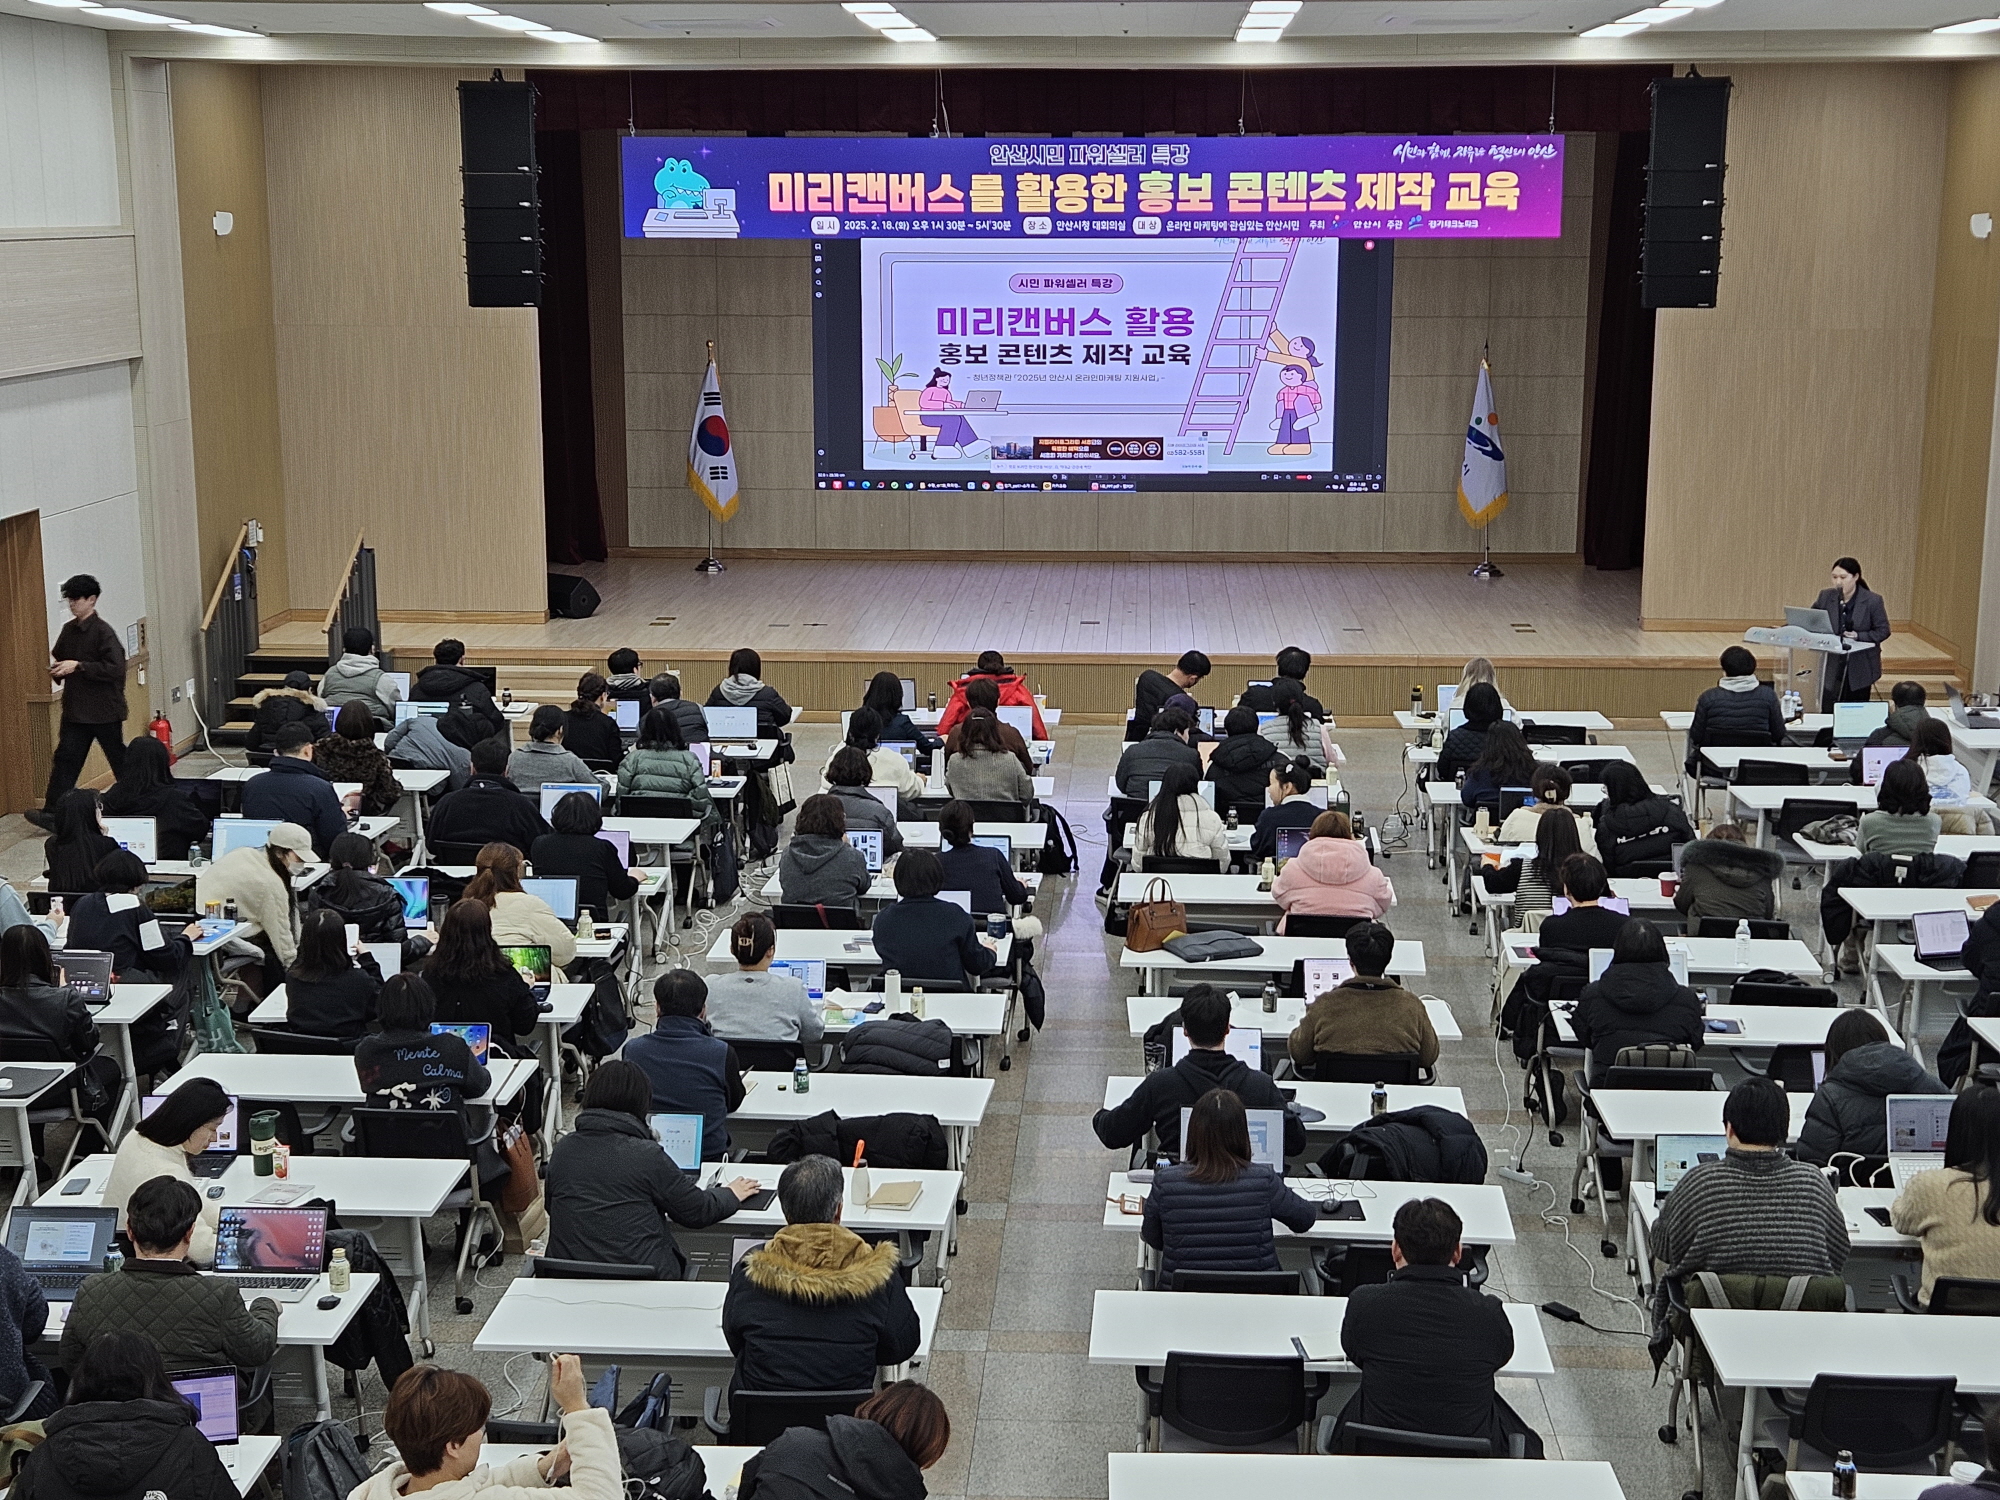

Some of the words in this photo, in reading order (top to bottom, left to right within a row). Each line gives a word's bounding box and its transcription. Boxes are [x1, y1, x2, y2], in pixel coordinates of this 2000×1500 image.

[990, 144, 1064, 166] 안산시민
[1069, 144, 1146, 166] 파워셀러
[1152, 144, 1190, 165] 특강
[1528, 143, 1558, 158] 안산
[768, 172, 1004, 214] 미리캔버스를
[1016, 172, 1128, 213] 활용한
[1138, 170, 1213, 212] 홍보
[1227, 170, 1346, 212] 콘텐츠
[1356, 171, 1436, 212] 제작
[1445, 171, 1520, 211] 교육
[844, 220, 869, 230] 2025.
[872, 220, 880, 230] 2.
[882, 220, 910, 231] 18.(화)
[912, 220, 929, 230] 오후
[932, 220, 944, 230] 1시
[948, 220, 966, 230] 30분
[976, 220, 990, 230] 5시
[992, 221, 1011, 231] 30분
[1056, 221, 1090, 232] 안산시청
[1092, 221, 1126, 232] 대회의실
[1166, 220, 1192, 232] 온라인
[1194, 220, 1228, 232] 마케팅에
[1230, 220, 1264, 232] 관심있는
[1266, 220, 1300, 231] 안산시민
[1309, 220, 1325, 230] 주최
[1386, 220, 1403, 230] 주관
[1428, 220, 1478, 229] 경기테크노파크
[1018, 278, 1040, 288] 시민
[1044, 278, 1088, 288] 파워셀러
[1091, 278, 1112, 288] 특강
[937, 306, 1112, 336] 미리캔버스
[1125, 306, 1195, 336] 활용
[938, 342, 988, 365] 홍보
[998, 344, 1072, 365] 콘텐츠
[1082, 344, 1132, 365] 제작
[1142, 344, 1192, 365] 교육
[1050, 374, 1073, 382] 안산시
[1075, 374, 1122, 382] 온라인마케팅
[394, 1046, 440, 1060] Mente
[422, 1064, 464, 1078] Calma
